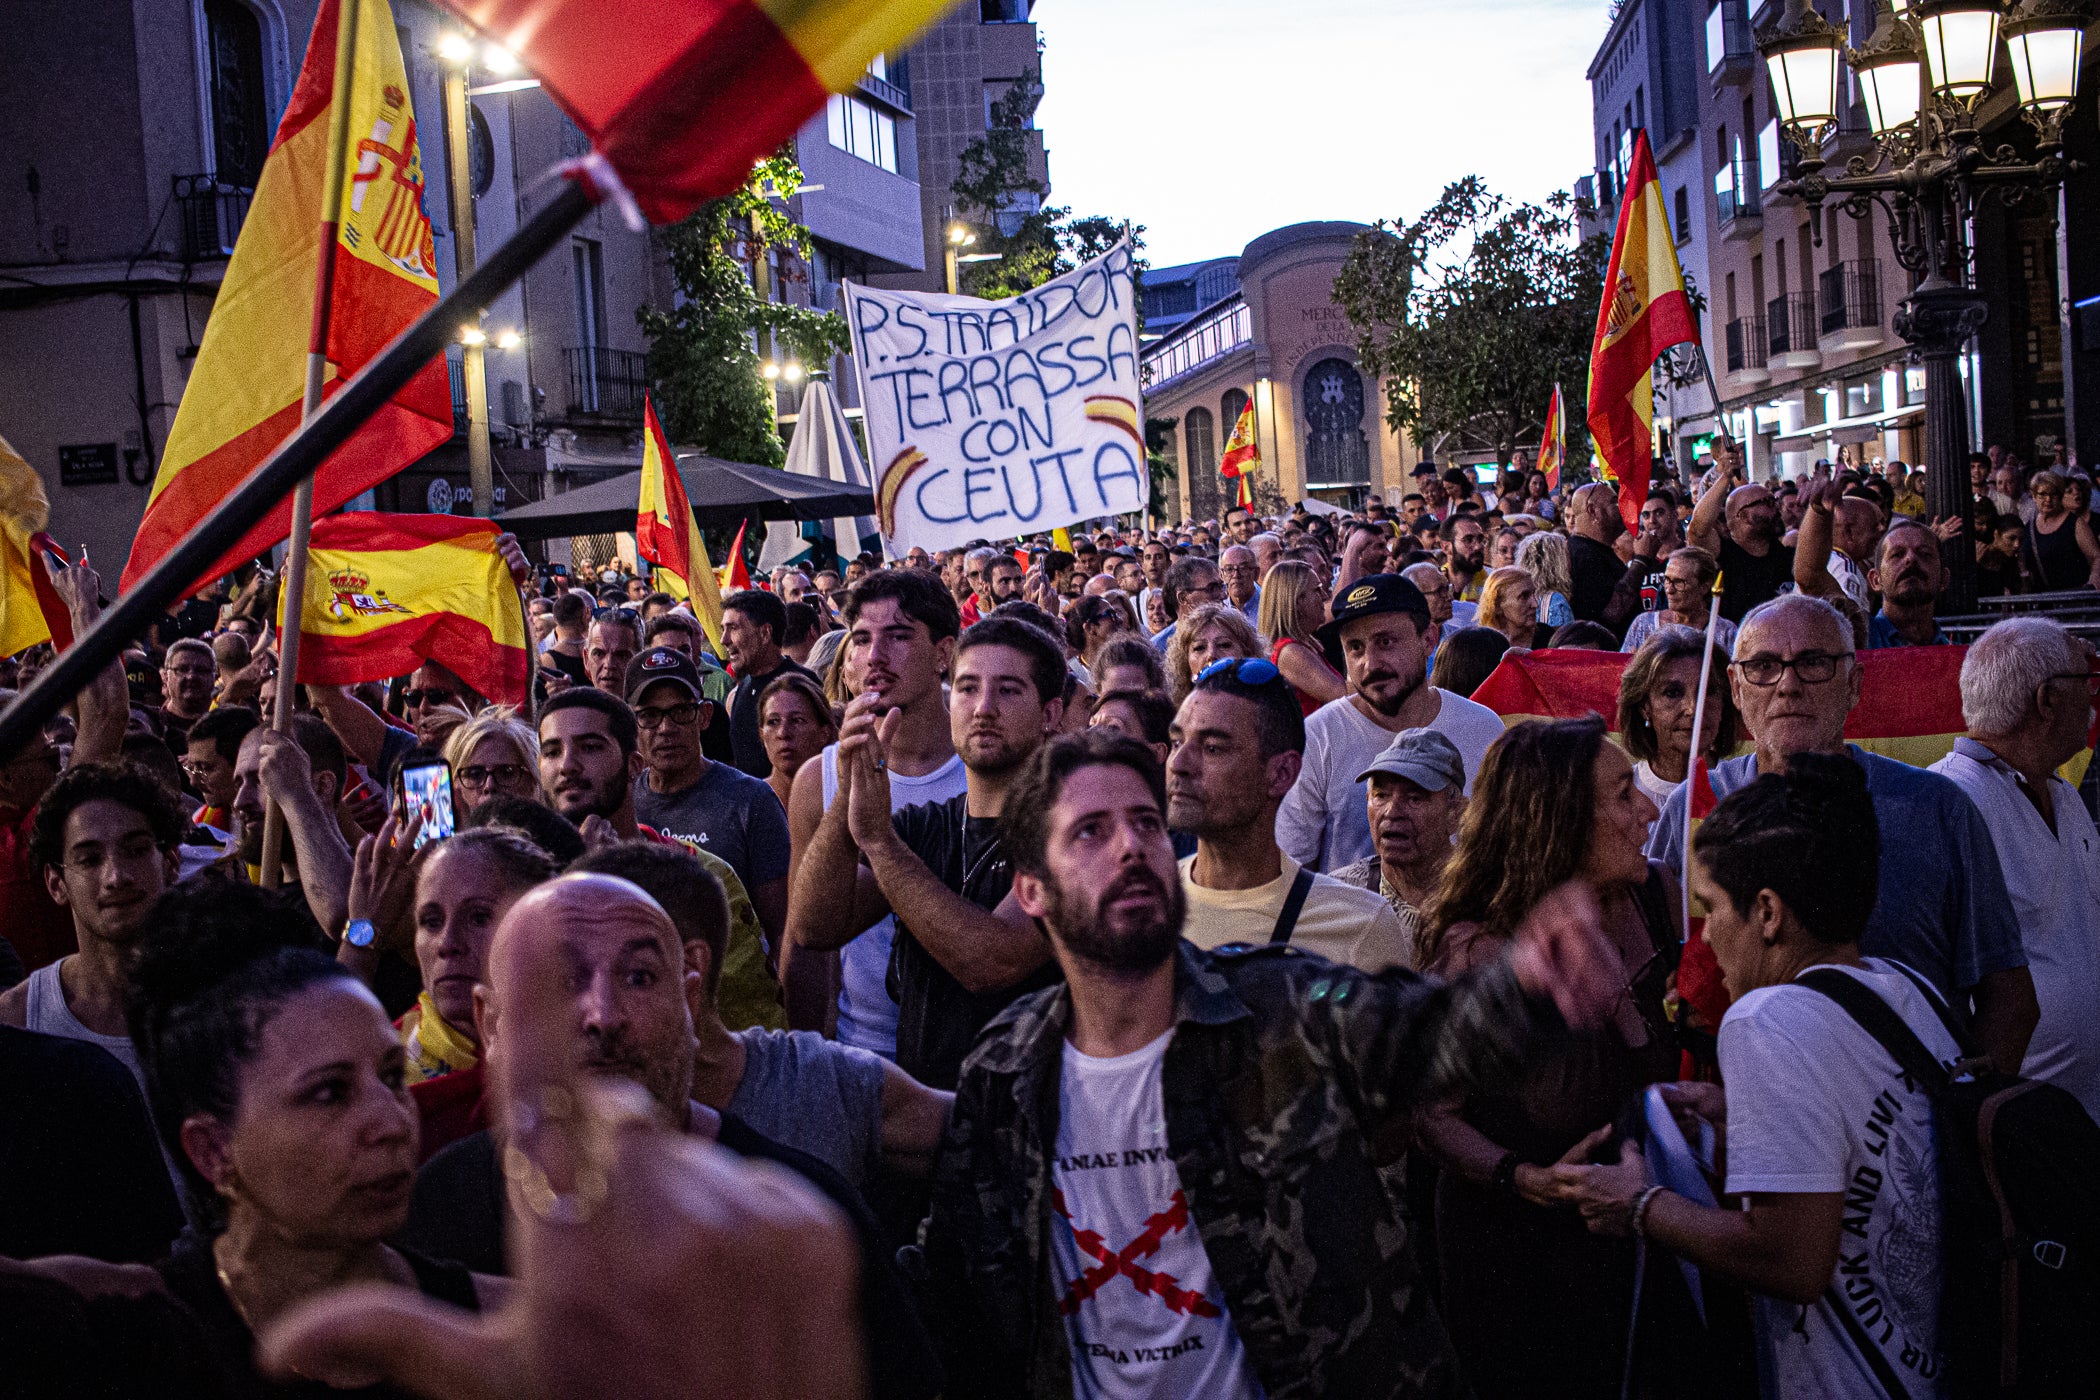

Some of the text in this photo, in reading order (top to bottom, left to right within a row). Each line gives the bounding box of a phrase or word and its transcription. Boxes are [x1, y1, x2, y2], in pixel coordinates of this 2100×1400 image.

[1301, 305, 1345, 320] MERC
[870, 323, 1137, 443] TERRASSA
[961, 402, 1053, 463] CON
[491, 487, 507, 502] ar
[916, 442, 1140, 523] CEUTA
[1053, 1147, 1166, 1173] ANIAE INV
[1842, 1165, 1883, 1239] AND
[1840, 1251, 1894, 1345] LUCK
